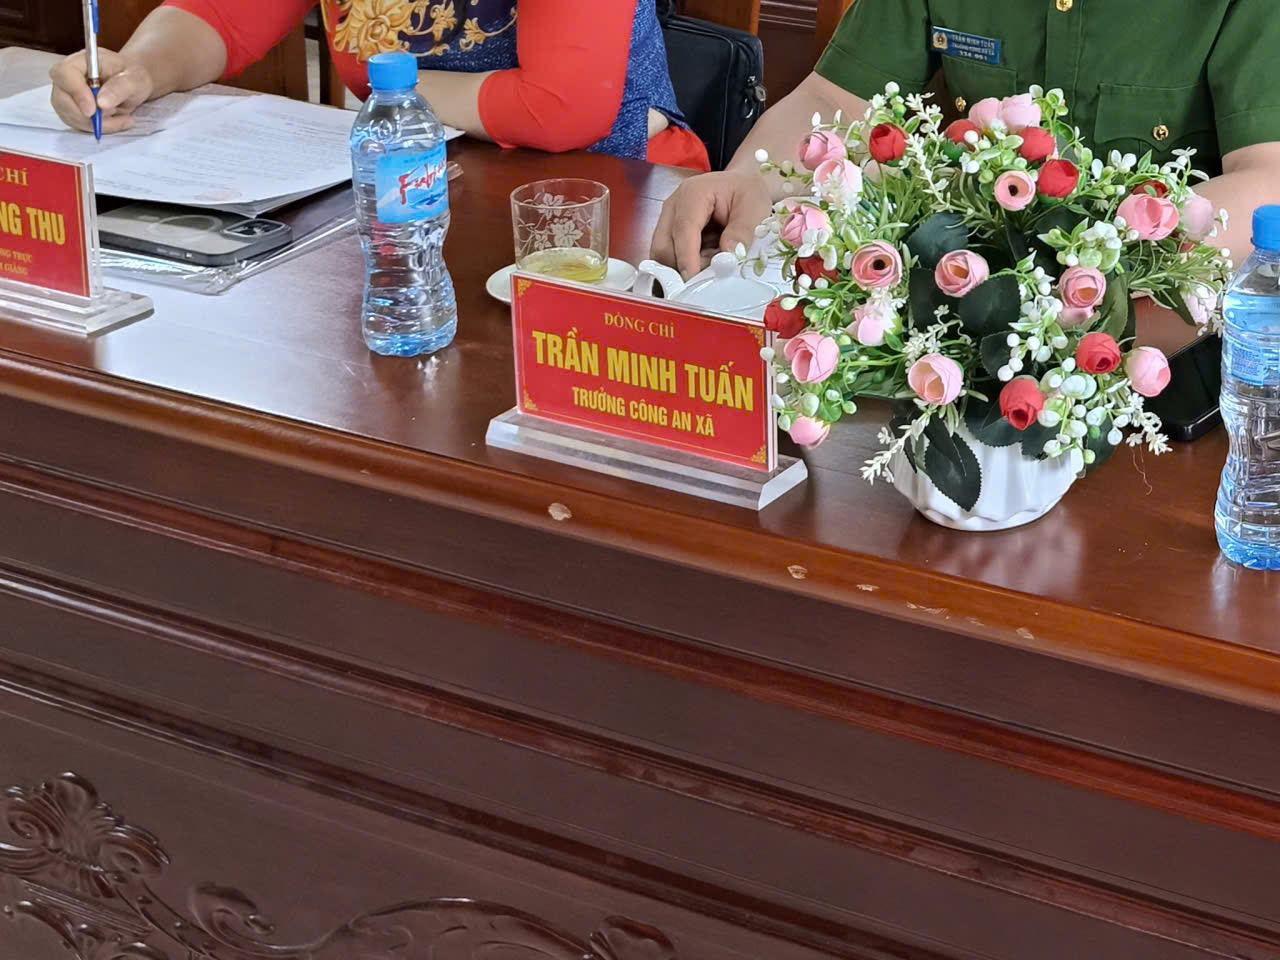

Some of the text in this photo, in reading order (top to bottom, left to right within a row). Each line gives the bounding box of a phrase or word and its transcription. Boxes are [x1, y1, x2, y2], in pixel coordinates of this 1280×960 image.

[26, 207, 66, 245] THU
[649, 321, 675, 338] CHÍ
[532, 327, 754, 411] TRẦN MINH TUẤN
[572, 387, 715, 437] TRƯỞNG CÔNG AN XÃ
